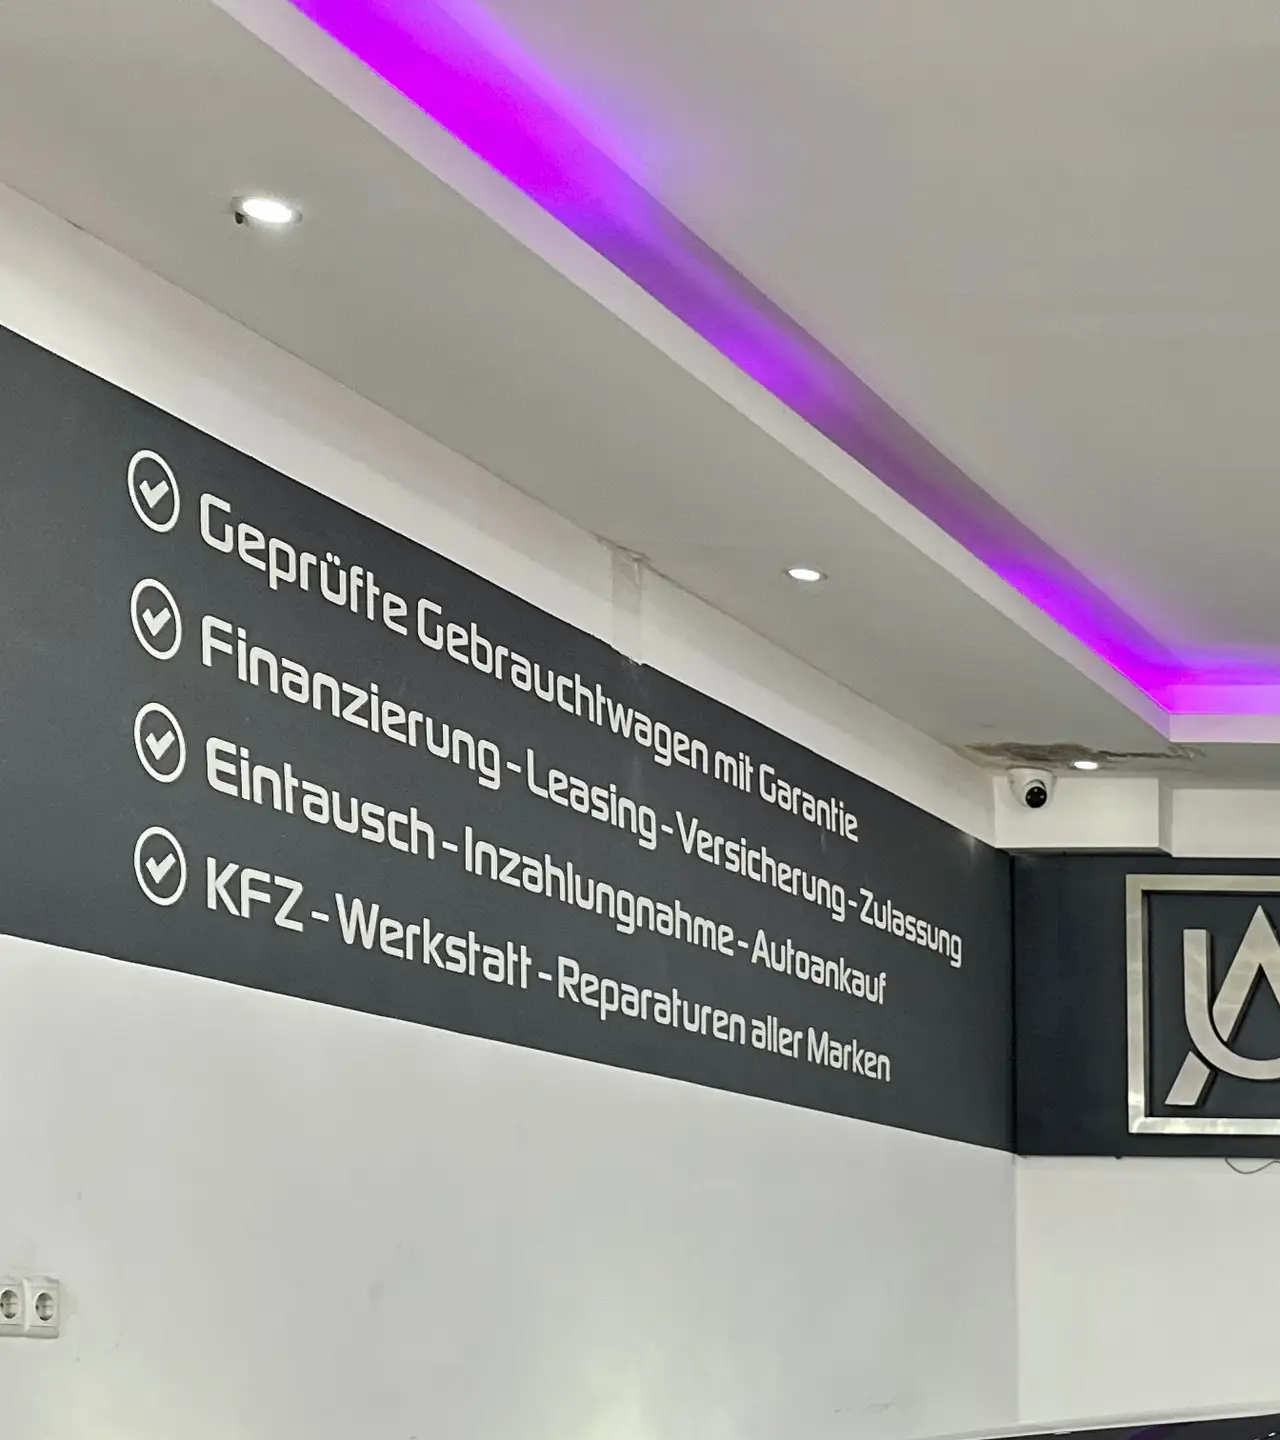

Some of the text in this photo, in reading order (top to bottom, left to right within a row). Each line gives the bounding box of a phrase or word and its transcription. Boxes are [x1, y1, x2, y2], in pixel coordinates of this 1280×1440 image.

[200, 492, 860, 844] Geprüfte Gebrauchtwagen mit Garantie
[751, 1014, 803, 1059] aller
[806, 1026, 892, 1083] Marken
